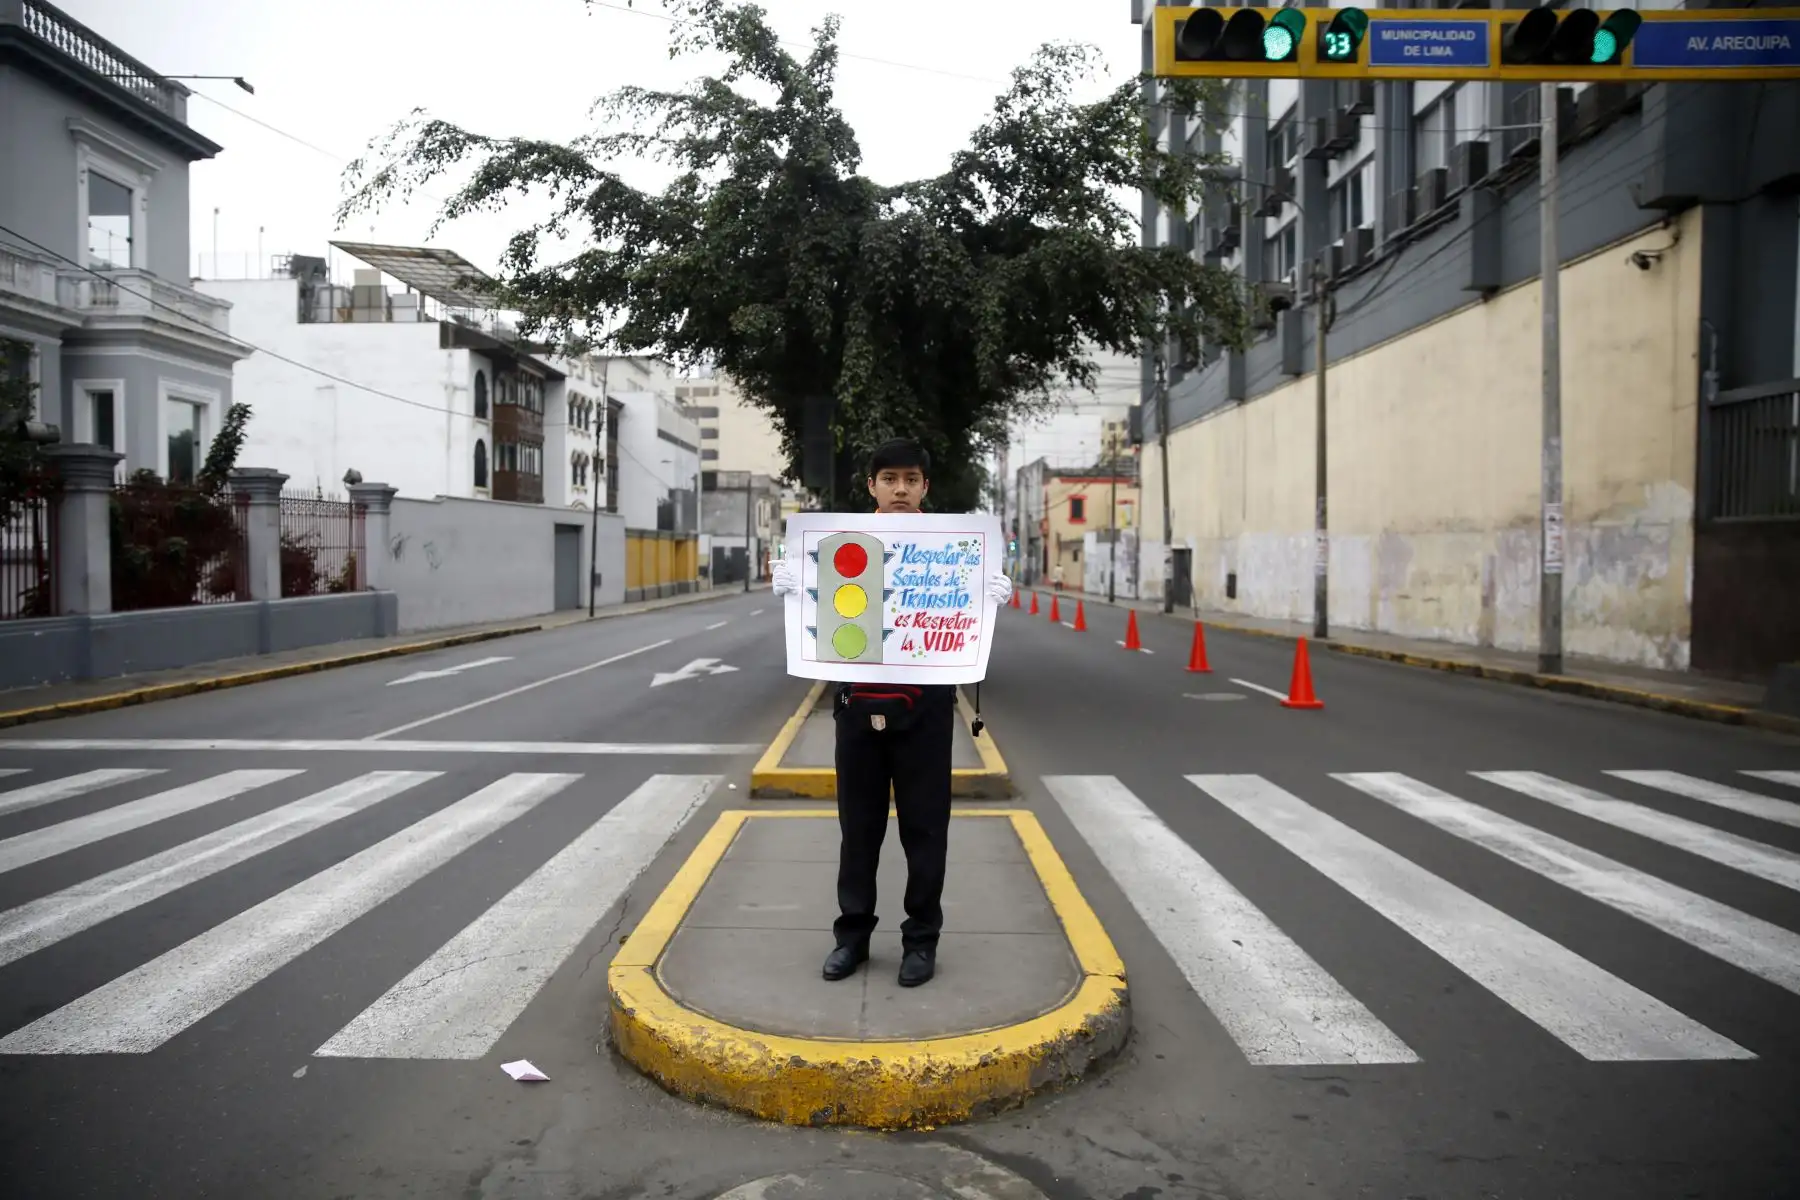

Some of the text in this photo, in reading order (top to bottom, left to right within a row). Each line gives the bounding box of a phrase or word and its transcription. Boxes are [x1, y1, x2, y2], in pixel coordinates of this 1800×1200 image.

[1381, 30, 1476, 41] MUNICIPALIDAD
[1687, 35, 1791, 51] AV. AREQUIPA
[1403, 45, 1453, 57] DE LIMA
[892, 567, 960, 587] Señales de
[894, 611, 978, 630] es Respetar
[901, 632, 914, 652] la
